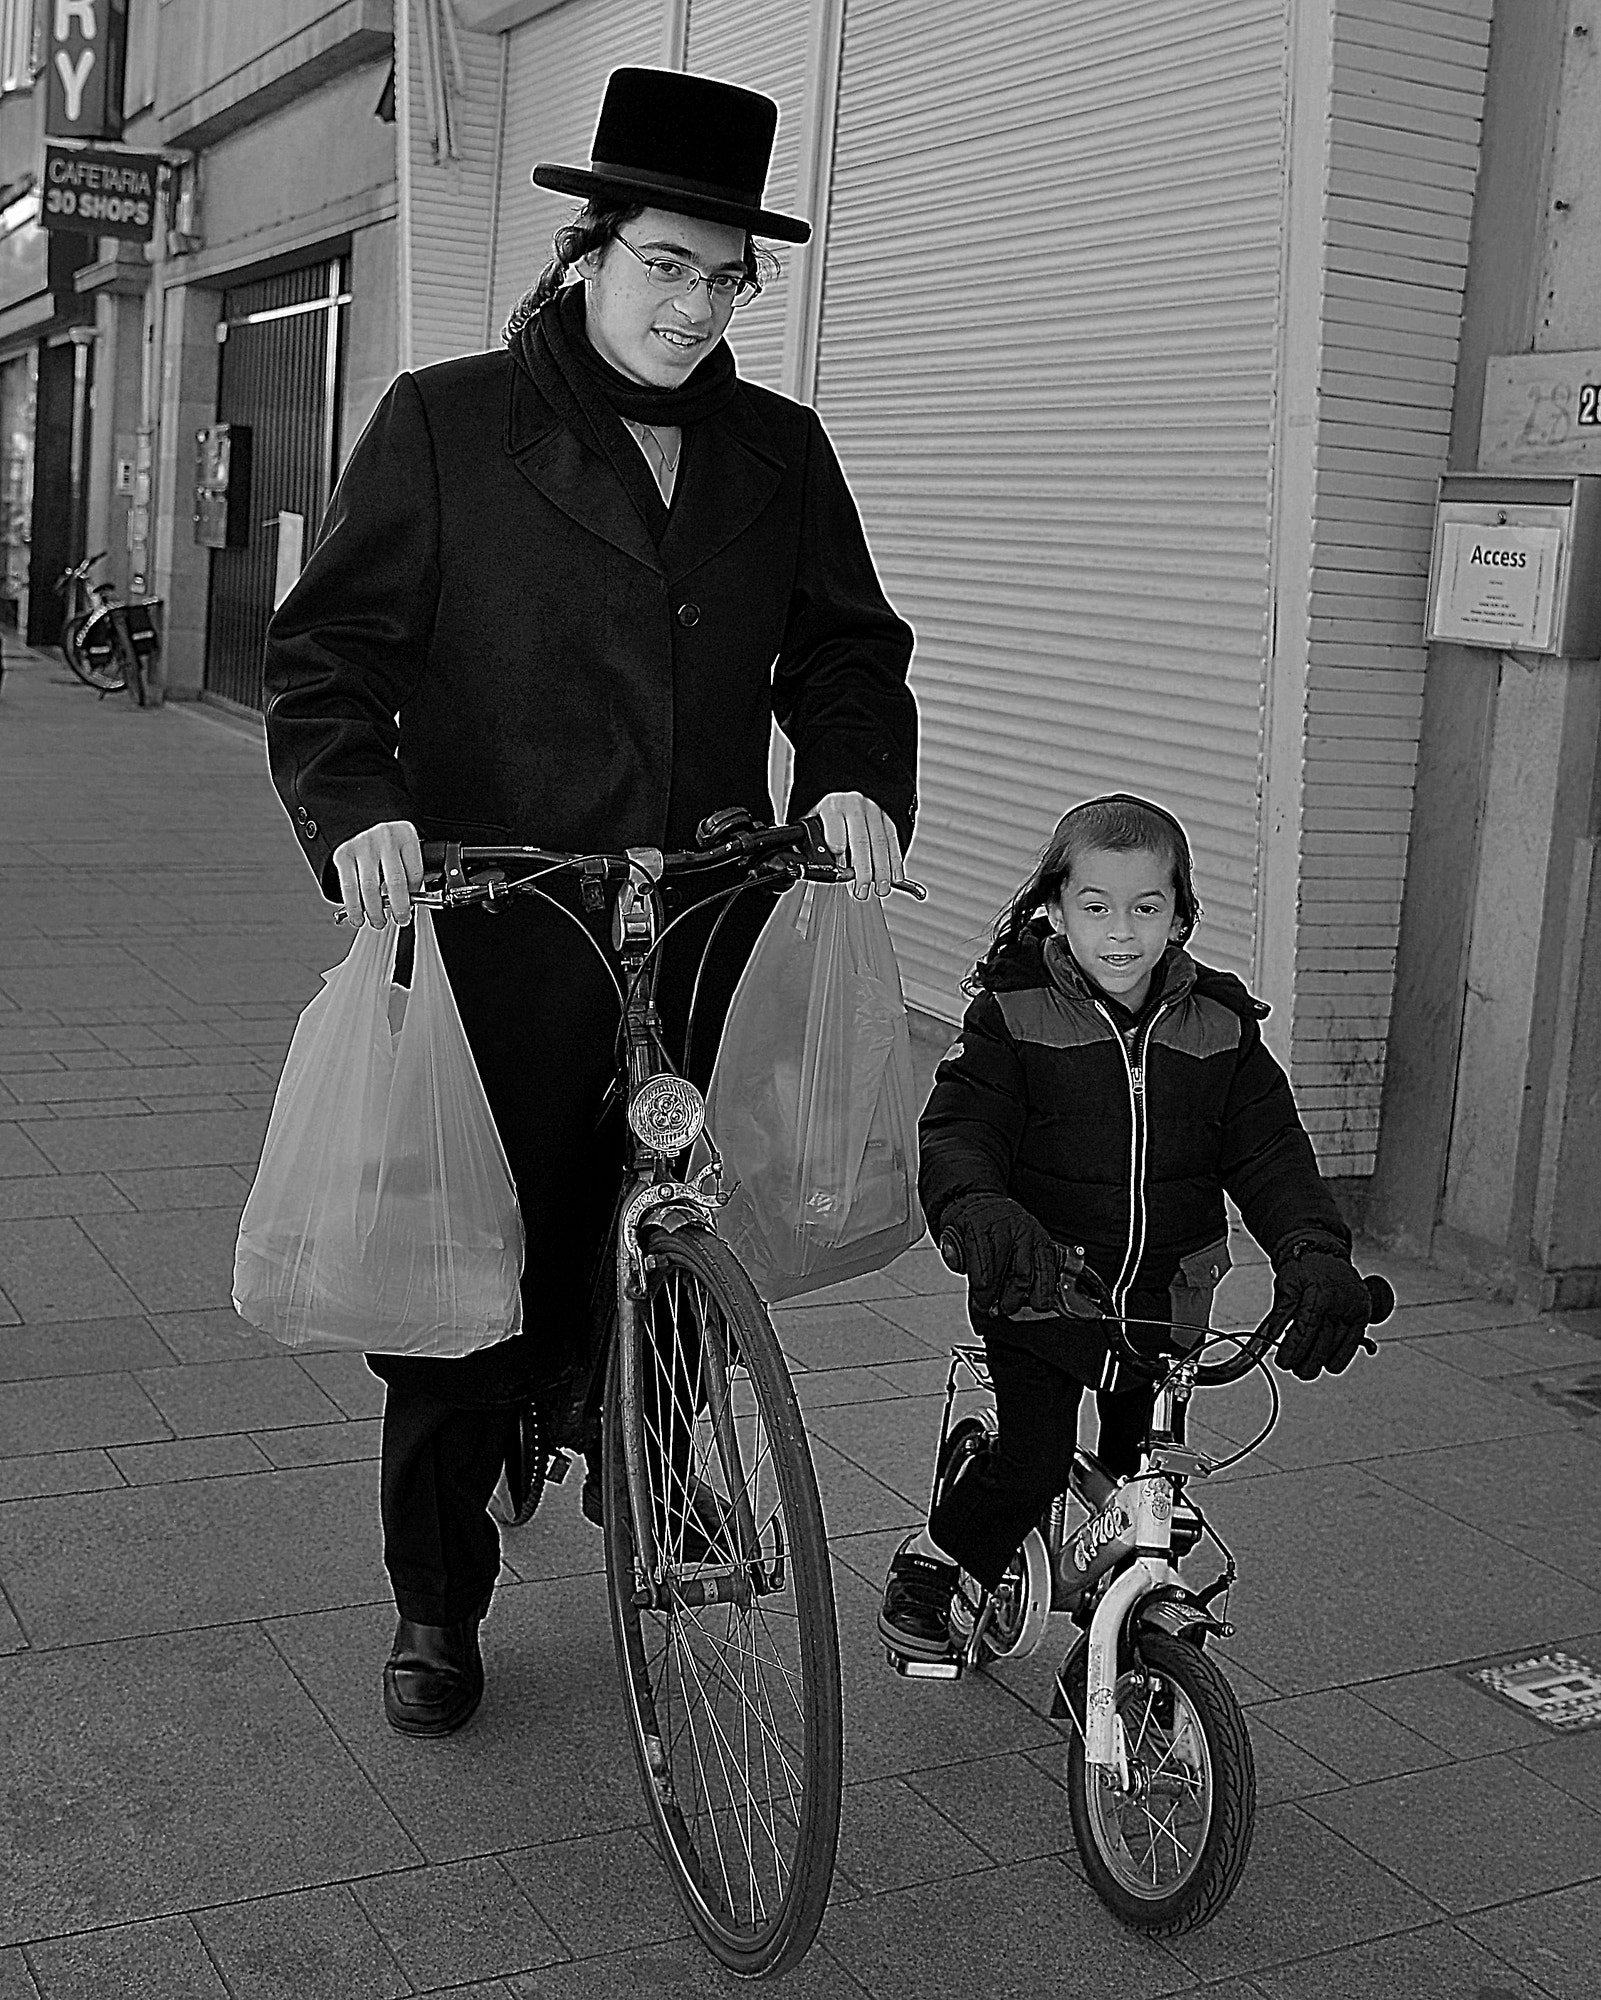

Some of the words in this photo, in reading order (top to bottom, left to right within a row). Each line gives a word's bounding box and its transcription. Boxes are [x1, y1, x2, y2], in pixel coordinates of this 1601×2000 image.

[49, 157, 151, 196] CAFETARIA
[78, 192, 150, 225] SHOPS
[1470, 545, 1527, 568] Access
